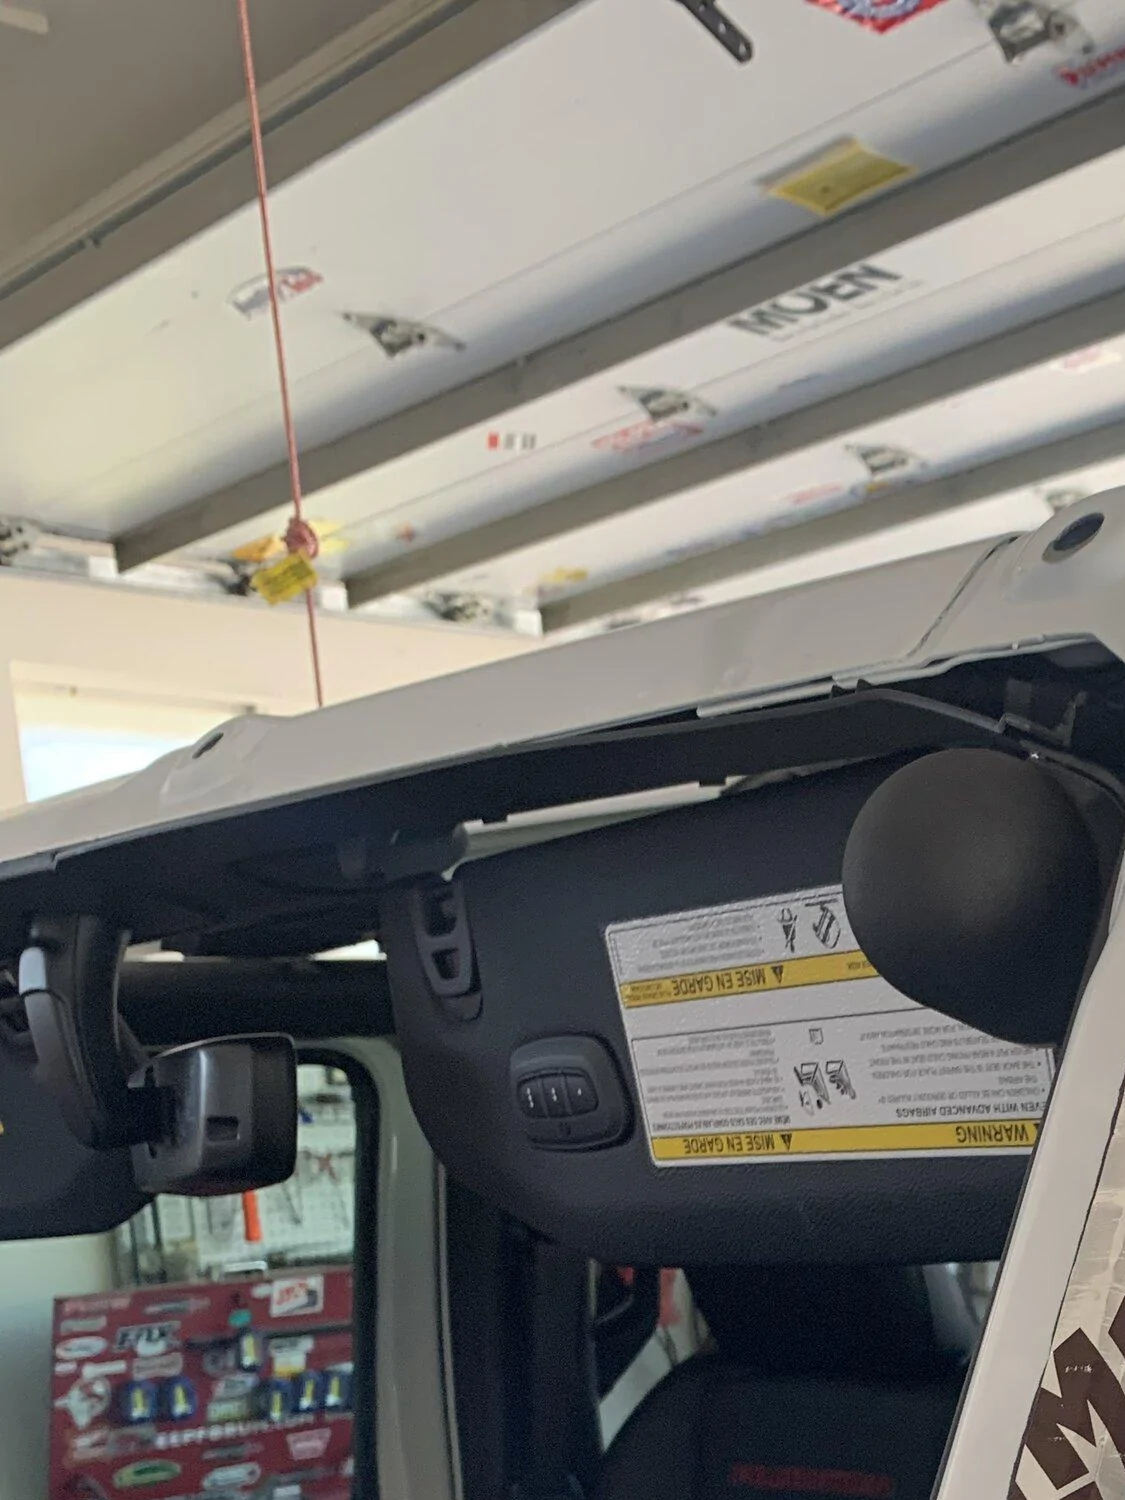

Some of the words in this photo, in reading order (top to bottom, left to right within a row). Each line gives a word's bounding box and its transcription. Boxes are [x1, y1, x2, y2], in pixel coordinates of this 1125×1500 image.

[672, 974, 714, 996] GARDE
[717, 971, 733, 991] EN
[736, 967, 766, 988] MISE
[895, 1106, 937, 1117] AIRBAGS
[939, 1104, 990, 1115] ADVANCED
[993, 1103, 1017, 1113] WITH
[745, 1133, 775, 1151] MISE
[956, 1123, 1029, 1144] WARNING
[683, 1137, 724, 1154] GARDE
[726, 1136, 742, 1151] EN
